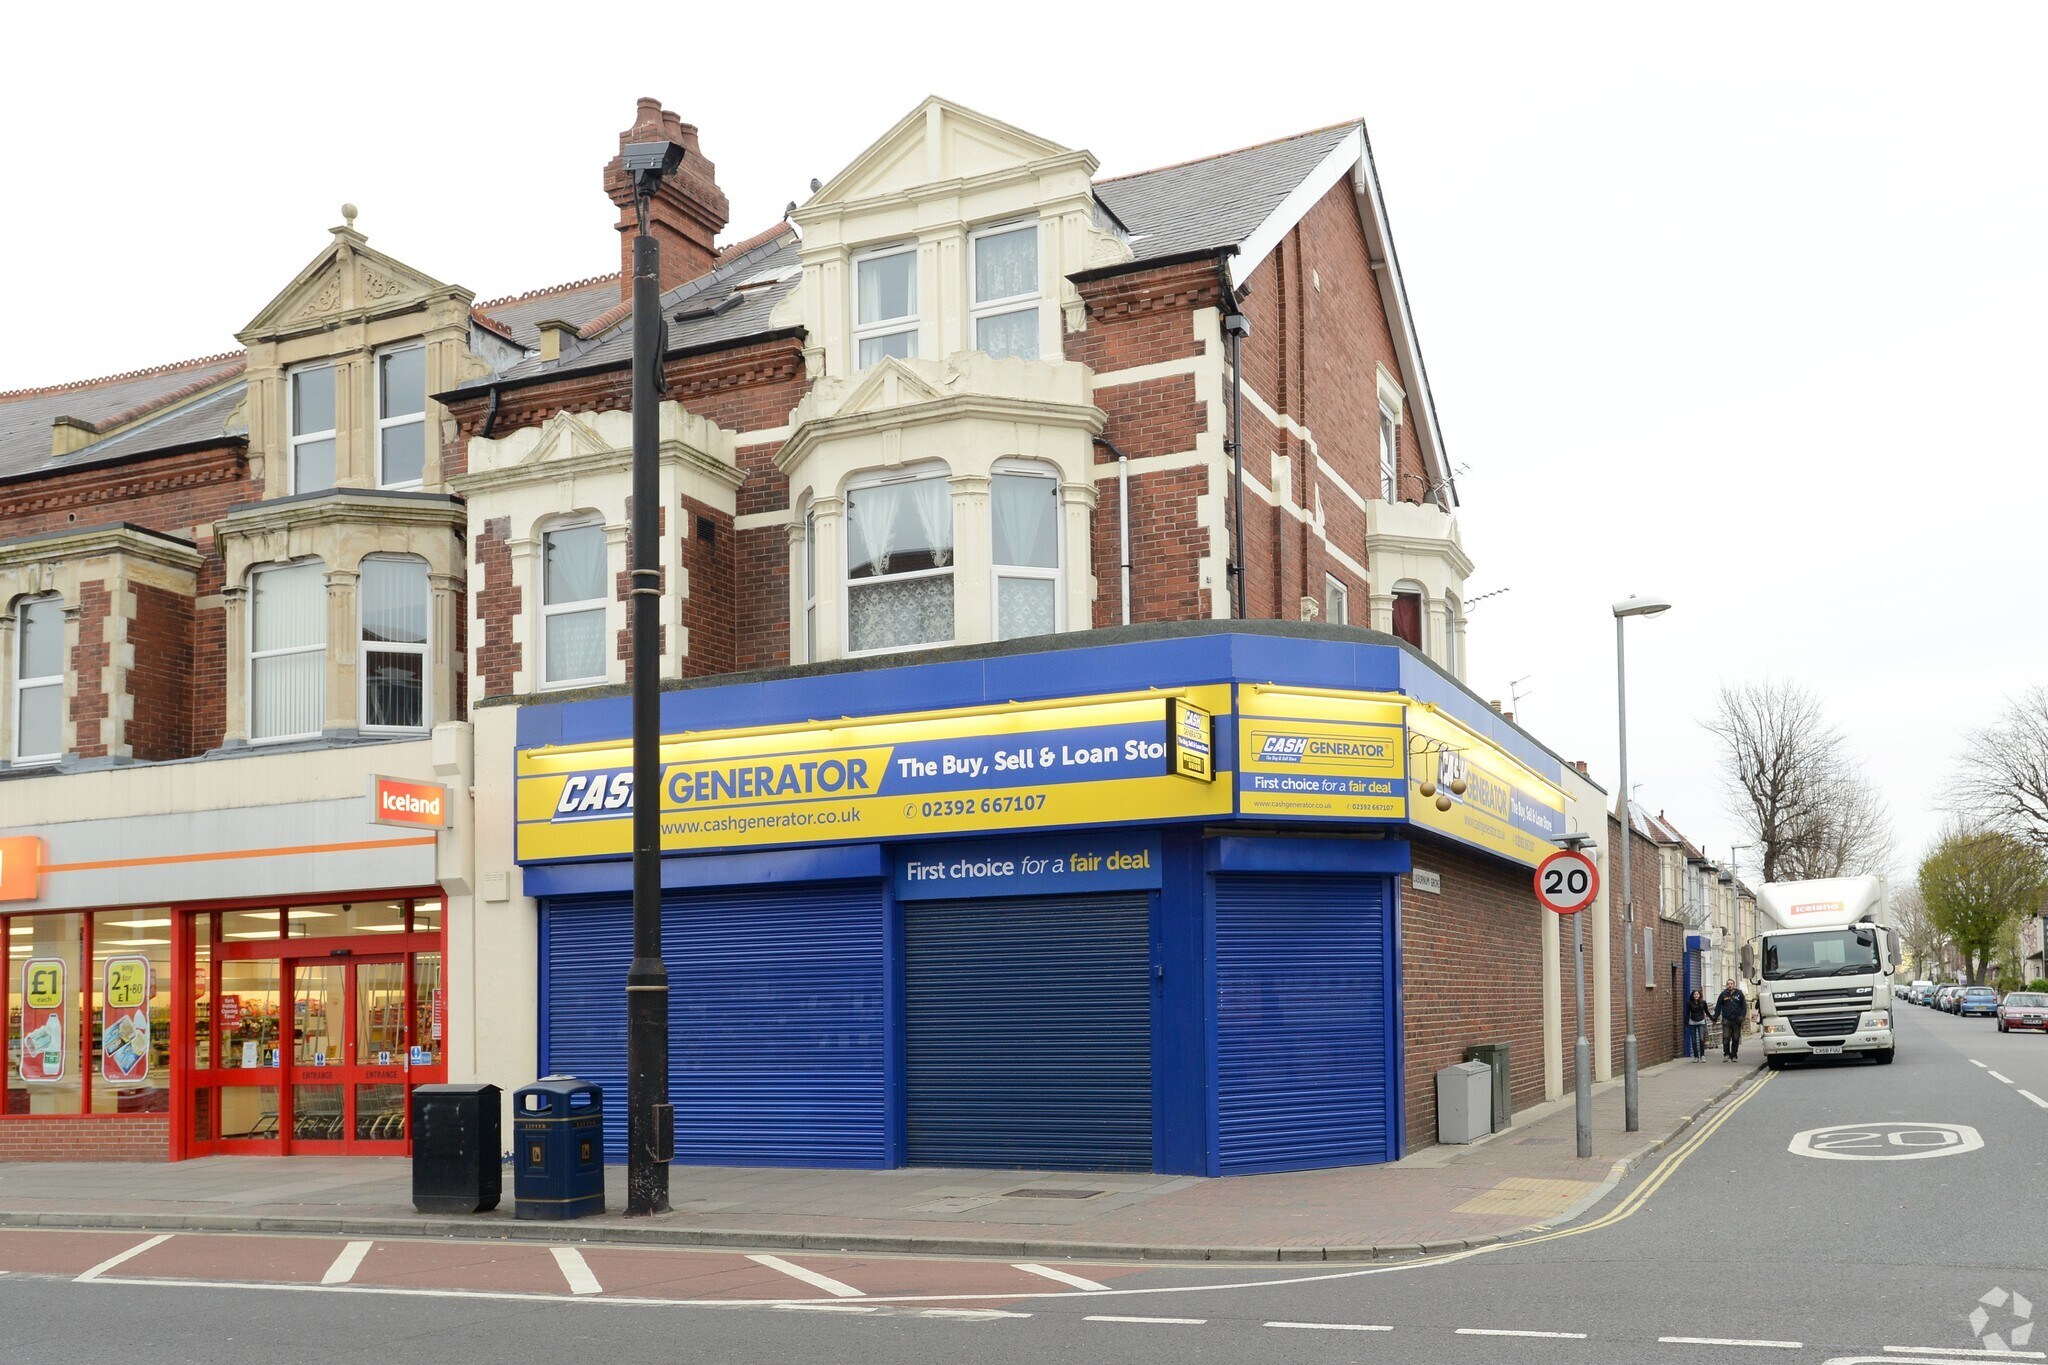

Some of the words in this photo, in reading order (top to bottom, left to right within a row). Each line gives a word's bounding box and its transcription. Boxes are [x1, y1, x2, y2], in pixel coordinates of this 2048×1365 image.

[1185, 710, 1202, 729] CASH
[1264, 737, 1308, 754] CASH
[1310, 742, 1384, 757] GENERATOR
[898, 757, 938, 778] The
[943, 755, 989, 777] Buy,
[994, 749, 1034, 771] Sell
[1039, 747, 1056, 767] &
[1062, 746, 1118, 766] Loan
[557, 772, 633, 812] CAS
[668, 758, 869, 804] GENERATOR
[1255, 776, 1279, 790] First
[1280, 778, 1320, 791] choice
[1321, 779, 1338, 791] for
[1338, 782, 1346, 792] a
[1349, 780, 1367, 793] fair
[1368, 781, 1392, 794] deal
[1466, 769, 1507, 816] GENERATOR
[383, 791, 440, 816] Iceland
[922, 799, 976, 818] 02392
[980, 794, 1047, 813] 667107
[1254, 800, 1332, 809] www.cashgenerator.co.uk
[1352, 803, 1371, 811] 02392
[661, 807, 861, 834] www.cashgenerator.co.uk
[907, 861, 946, 881] First
[950, 858, 1014, 878] choice
[1021, 856, 1048, 875] for
[1052, 858, 1064, 873] a
[1069, 853, 1102, 873] fair
[1106, 849, 1150, 871] deal
[1545, 869, 1588, 895] 20
[31, 970, 58, 995] £1
[111, 971, 121, 991] 2
[302, 1071, 333, 1079] ENTRANCE
[365, 1070, 398, 1079] ENTRANCE
[1814, 1130, 1959, 1149] 20
